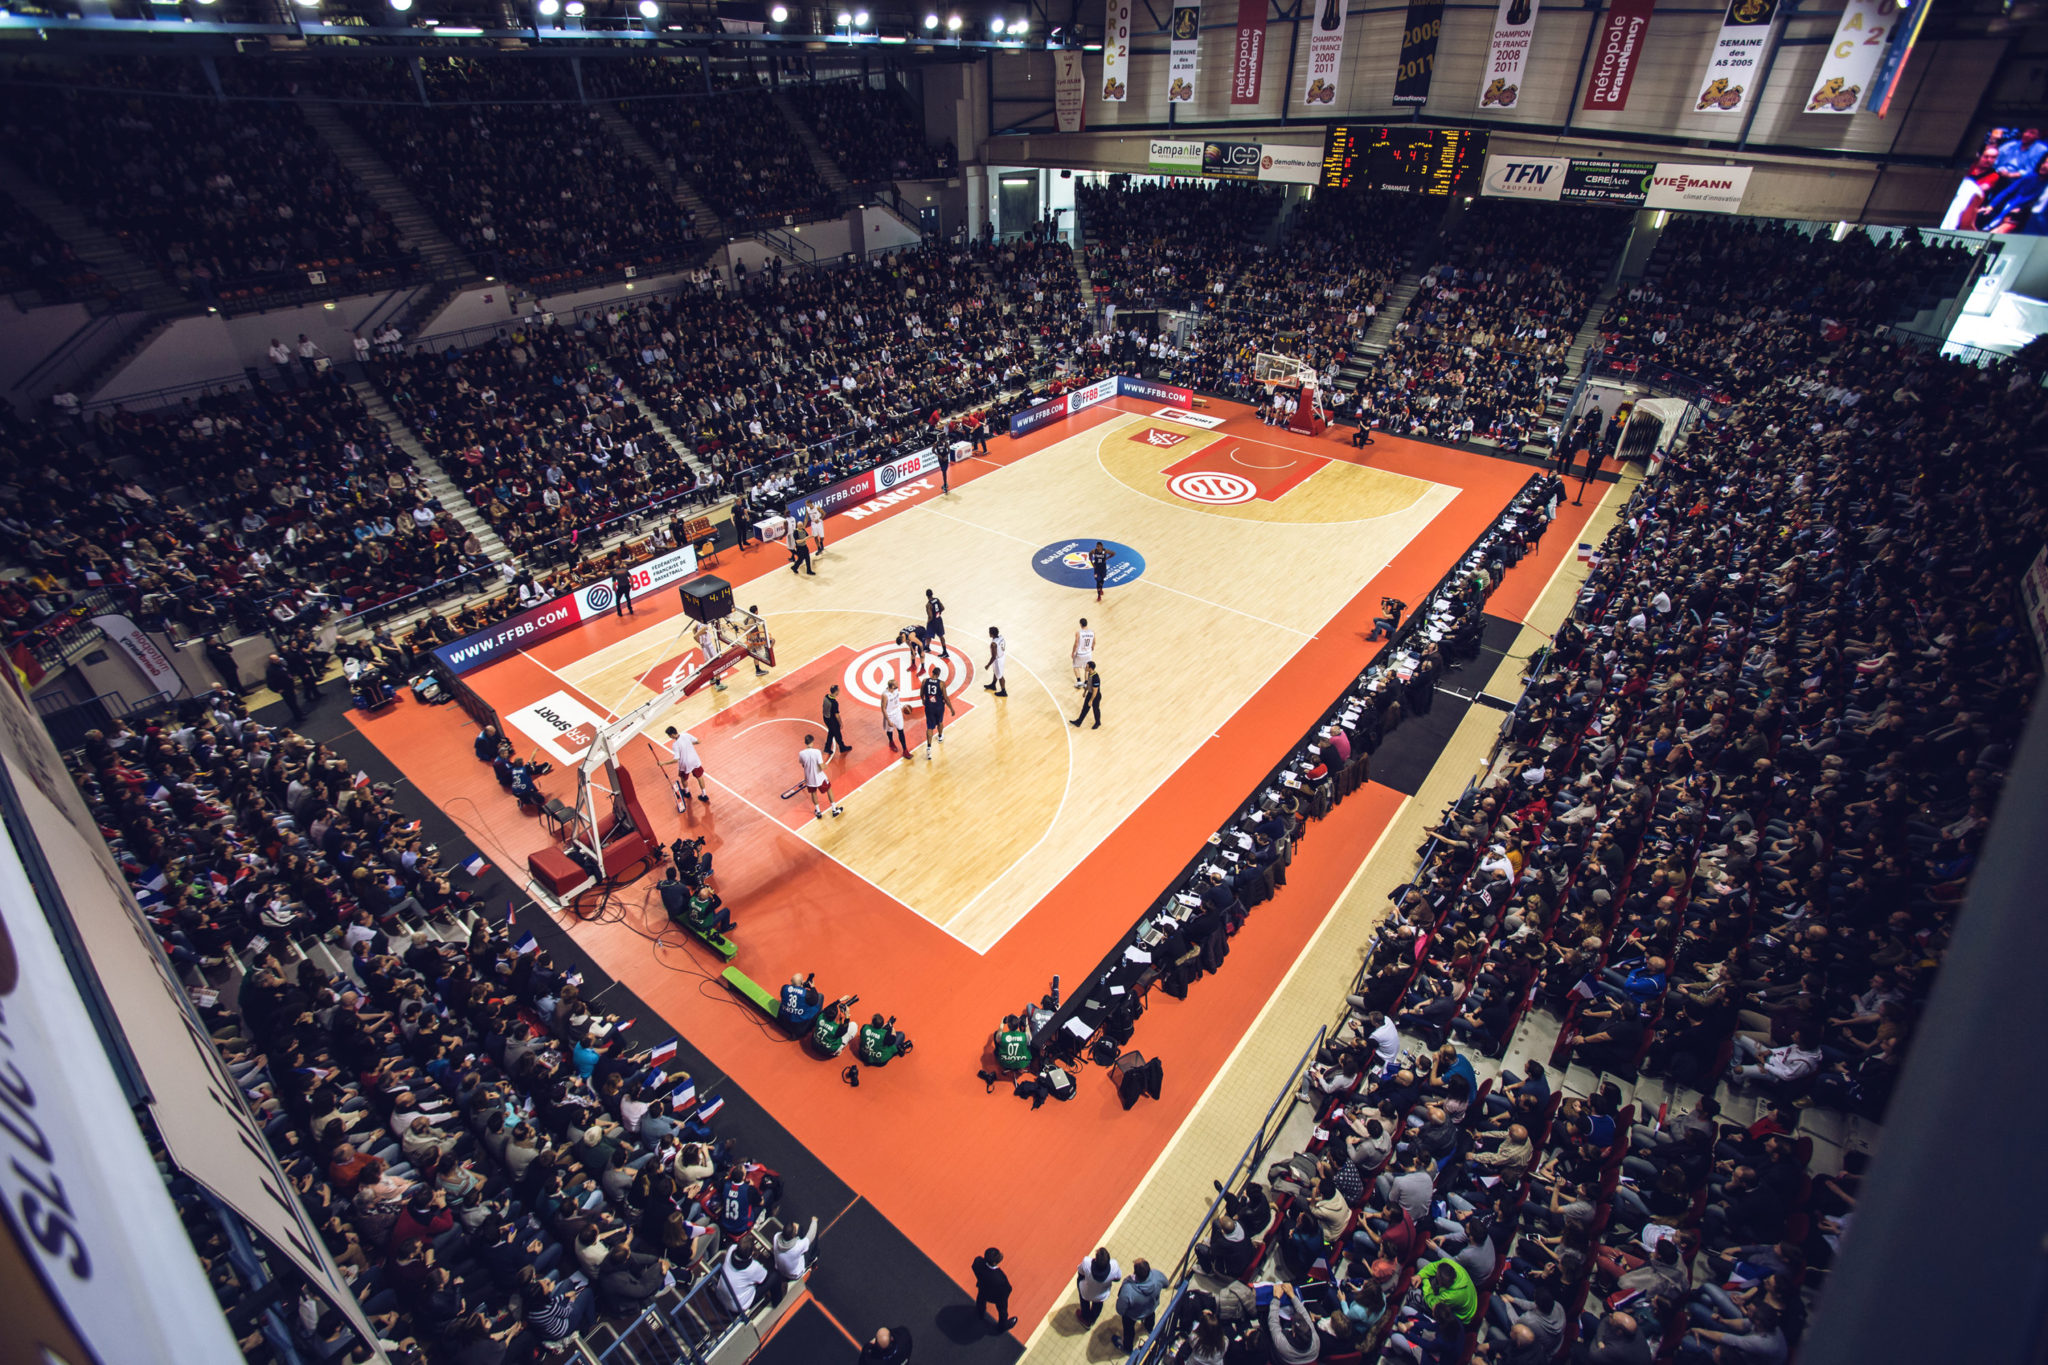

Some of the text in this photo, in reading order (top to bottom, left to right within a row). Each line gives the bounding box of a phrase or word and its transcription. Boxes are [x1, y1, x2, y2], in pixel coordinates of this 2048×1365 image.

[1312, 35, 1343, 43] CHAMPION
[1403, 19, 1440, 48] 2008
[1494, 30, 1532, 39] CHAMPION
[1502, 40, 1529, 48] FRANCE
[1720, 39, 1764, 47] SEMAINE
[1236, 28, 1250, 98] métropole
[1245, 29, 1263, 98] GrandNancy
[1315, 53, 1335, 63] 2008
[1496, 50, 1520, 60] 2008
[1593, 15, 1627, 103] métropole
[1607, 16, 1646, 103] GrandNancy
[1730, 59, 1753, 67] 2005
[1314, 63, 1334, 73] 2011
[1398, 54, 1433, 81] 2011
[1494, 62, 1518, 72] 2011
[1151, 143, 1201, 158] Campanile
[1223, 146, 1260, 165] JCD
[1274, 159, 1322, 168] demathieu bard
[1504, 163, 1553, 184] TFN
[1653, 174, 1733, 192] VIESSMANN
[1083, 388, 1098, 403] FFBB
[1124, 382, 1186, 402] WWW.FFBB.COM
[1016, 403, 1064, 428] WWW.FFBB.COM
[897, 457, 921, 476] FFBB
[841, 478, 935, 521] NANCY
[450, 607, 568, 665] WWW.FFBB.COM
[928, 684, 938, 695] 13
[534, 705, 572, 731] SPORT
[564, 728, 591, 745] SFR
[1007, 1043, 1020, 1056] 07
[725, 1198, 739, 1220] 13
